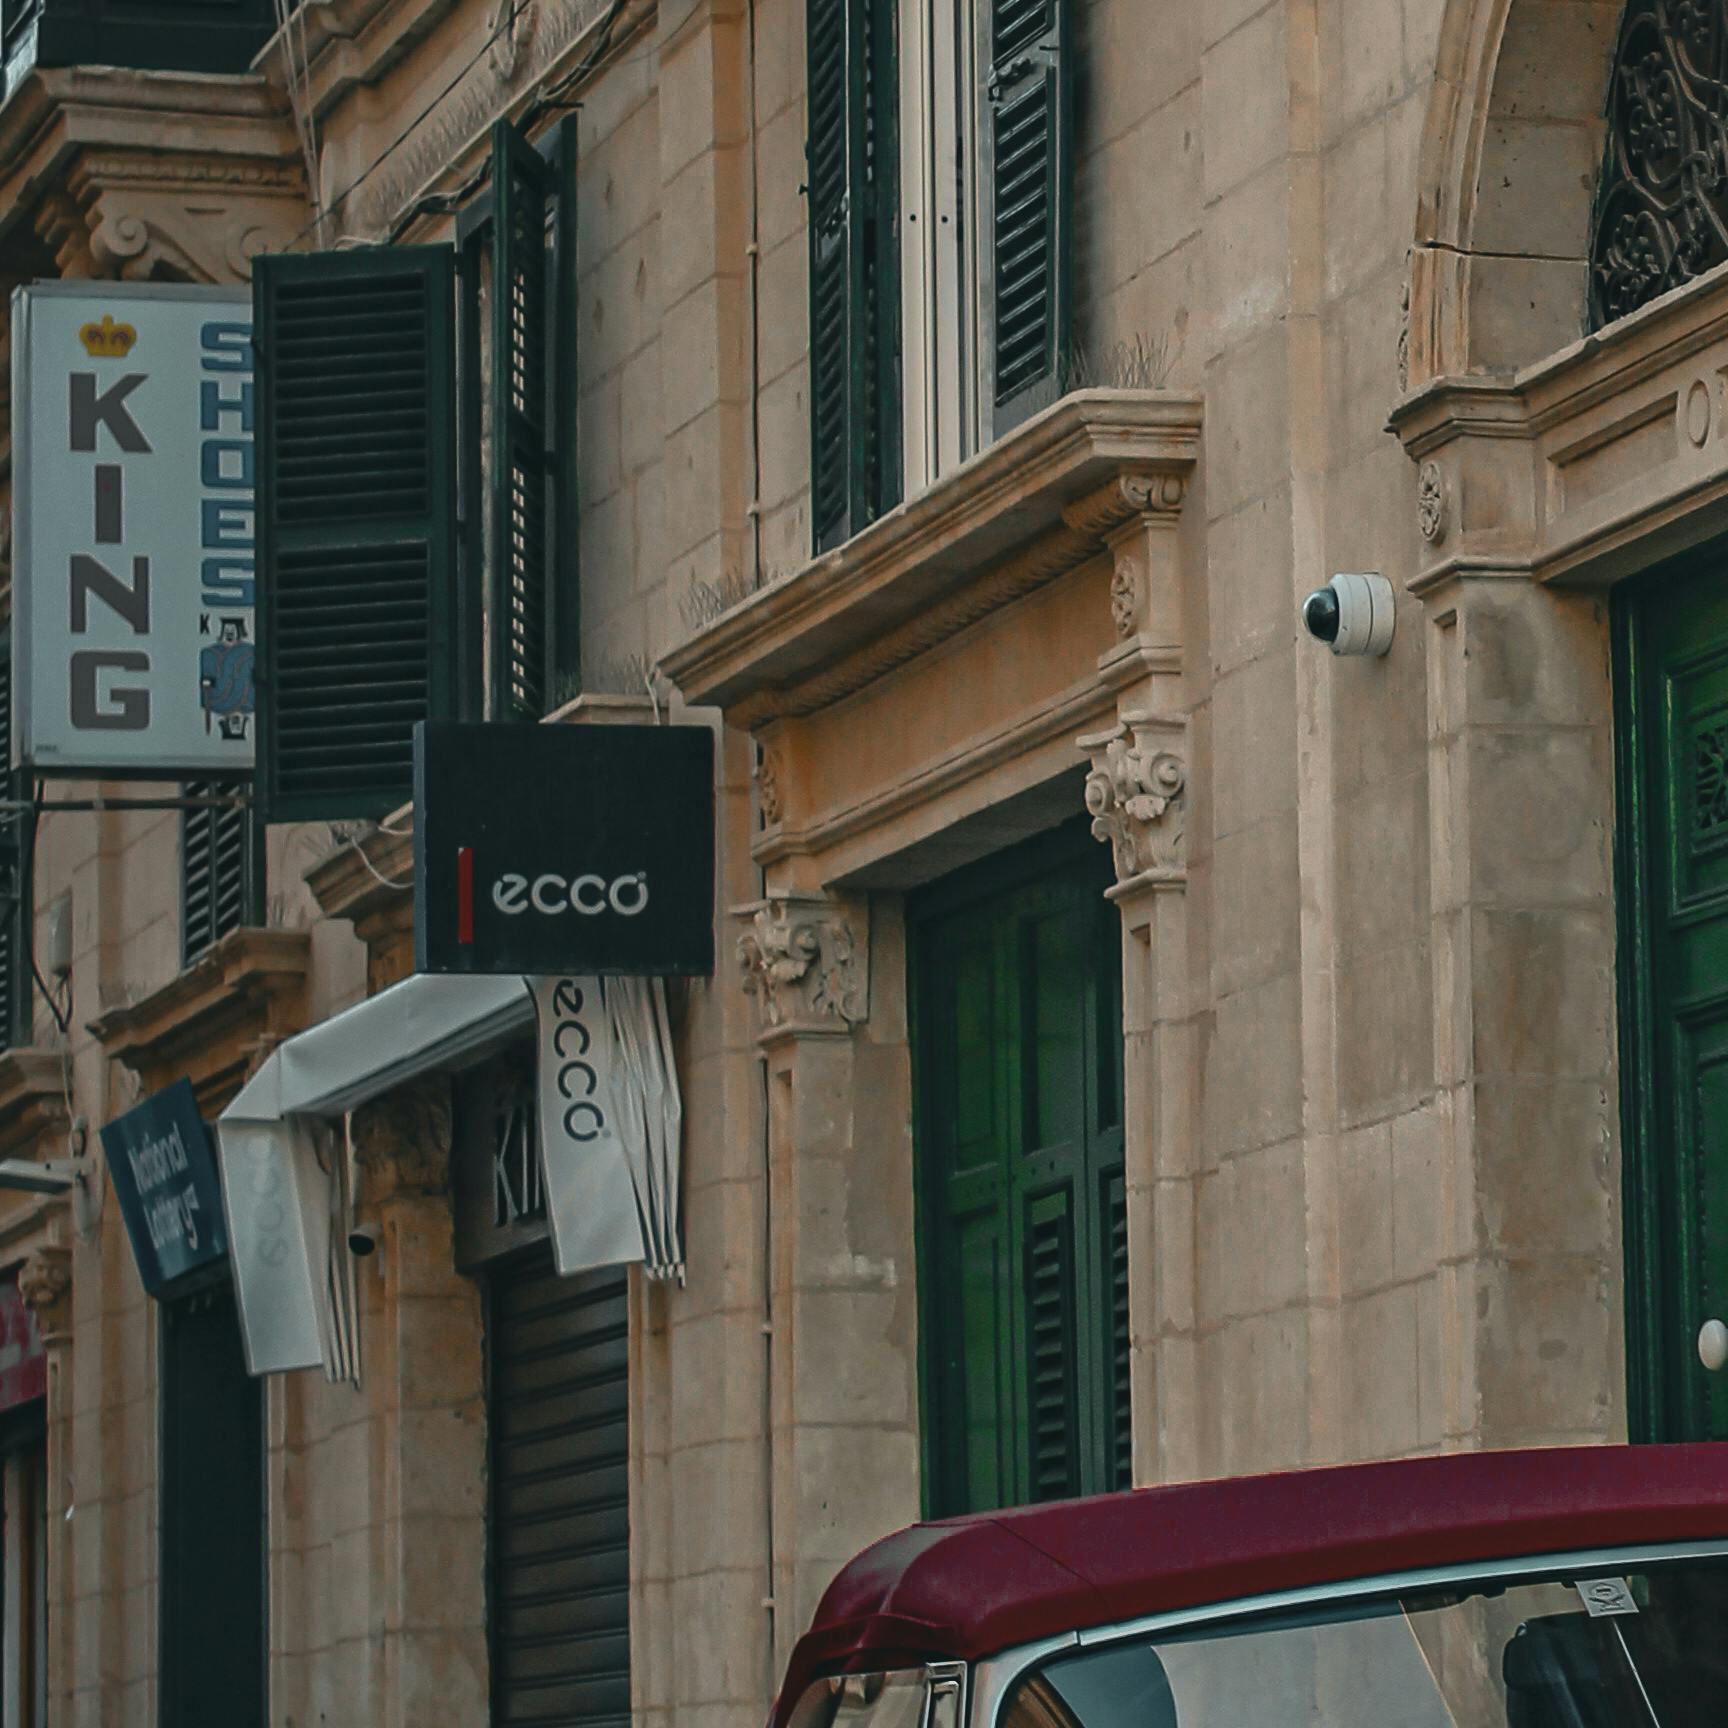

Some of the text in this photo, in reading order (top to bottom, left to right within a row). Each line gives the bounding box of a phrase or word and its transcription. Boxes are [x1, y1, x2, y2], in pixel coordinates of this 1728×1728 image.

[69, 372, 153, 730] KING
[201, 321, 255, 607] SHOES
[492, 874, 649, 915] ecco
[552, 978, 605, 1143] ecco
